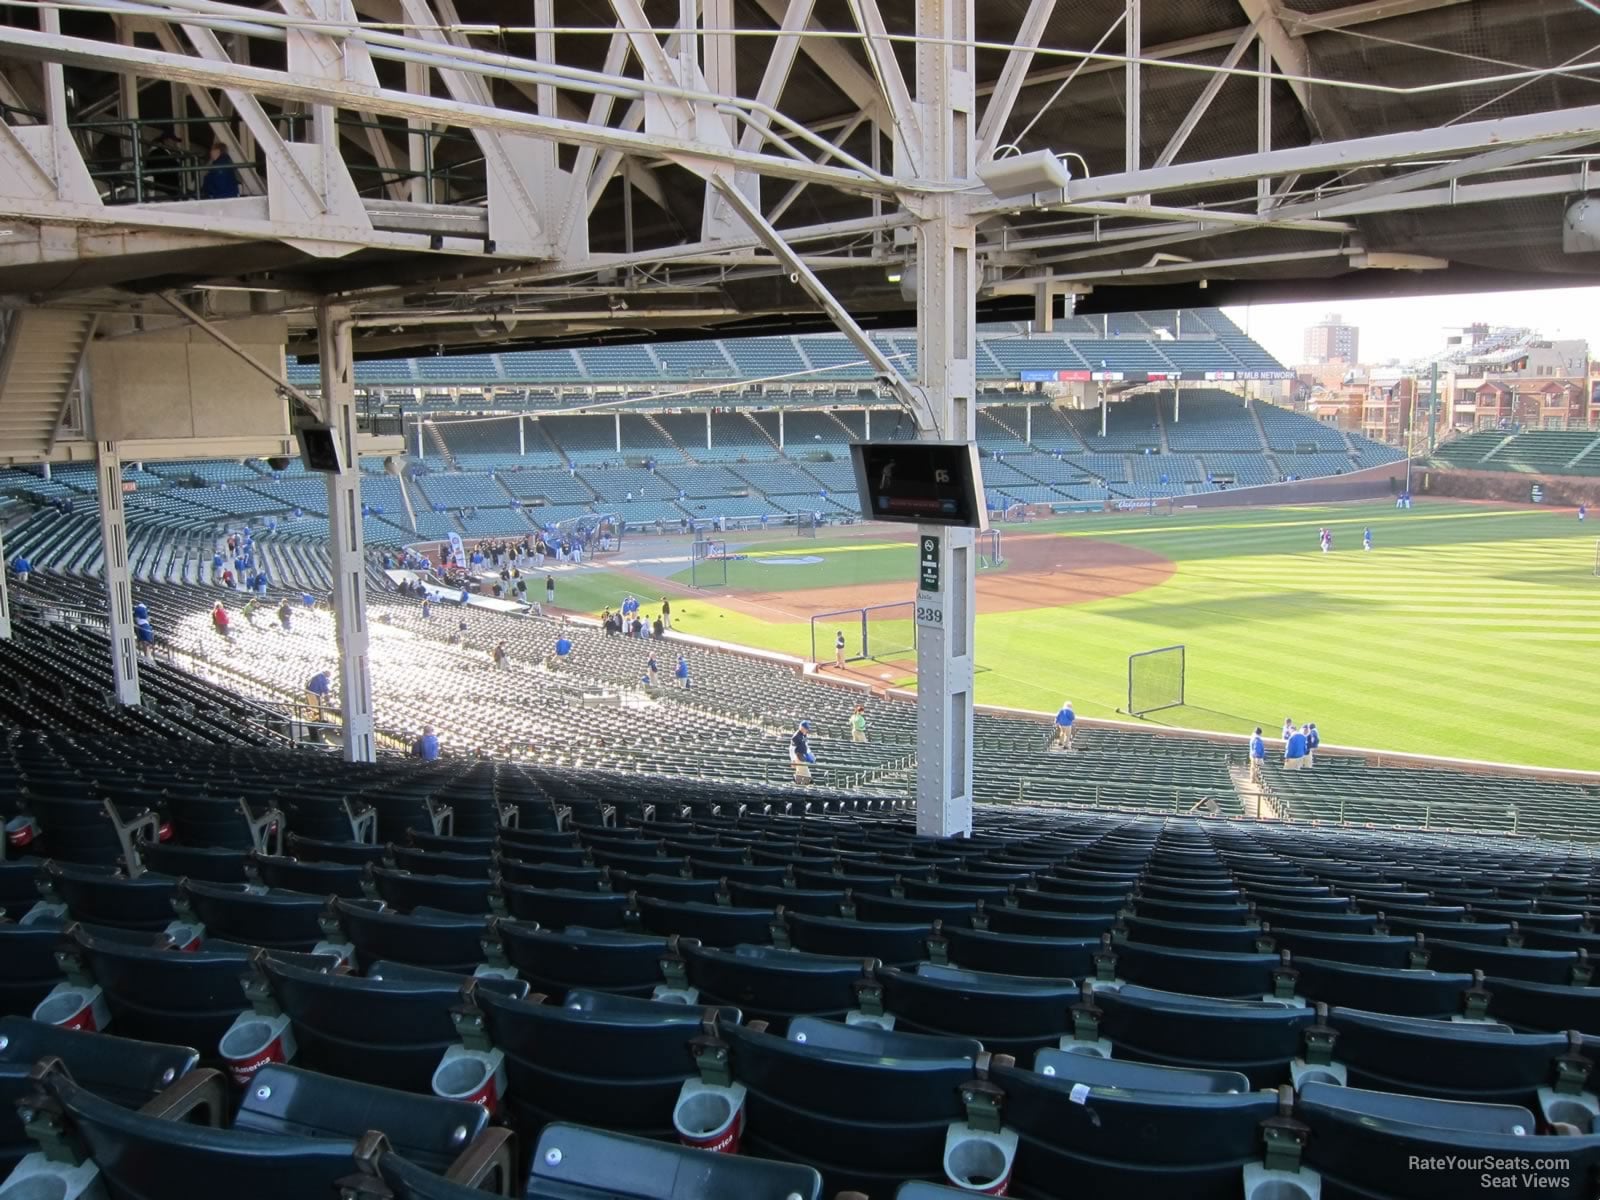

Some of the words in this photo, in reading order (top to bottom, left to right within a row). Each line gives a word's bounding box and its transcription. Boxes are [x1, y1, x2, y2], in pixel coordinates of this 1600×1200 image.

[1244, 371, 1260, 380] MLB
[1260, 371, 1296, 380] NETWORK
[917, 607, 943, 623] 239
